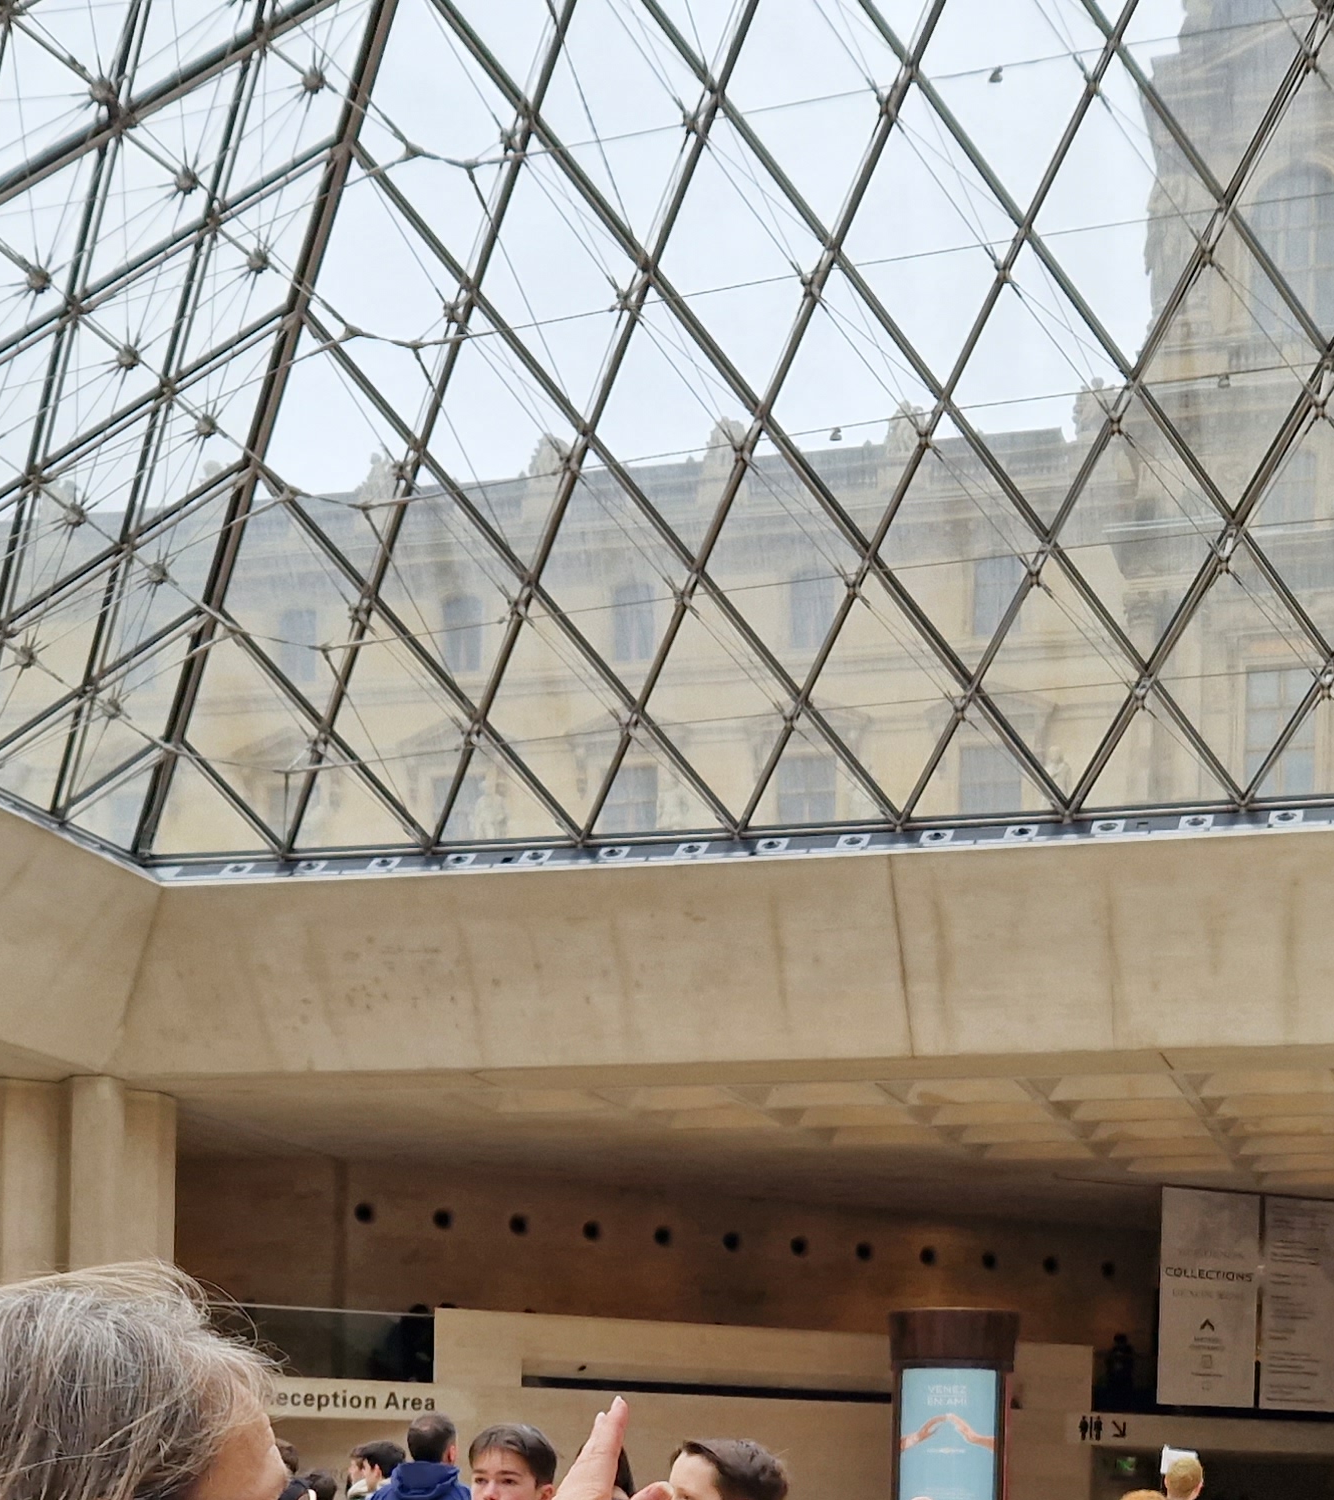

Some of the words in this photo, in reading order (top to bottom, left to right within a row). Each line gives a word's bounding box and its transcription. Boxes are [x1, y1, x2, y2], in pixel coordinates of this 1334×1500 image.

[1164, 1266, 1254, 1282] COLLECTIONS
[927, 1384, 968, 1394] VENEZ
[269, 1389, 377, 1412] eception
[384, 1391, 436, 1411] Area
[927, 1396, 943, 1406] EN
[946, 1397, 968, 1407] AMI
